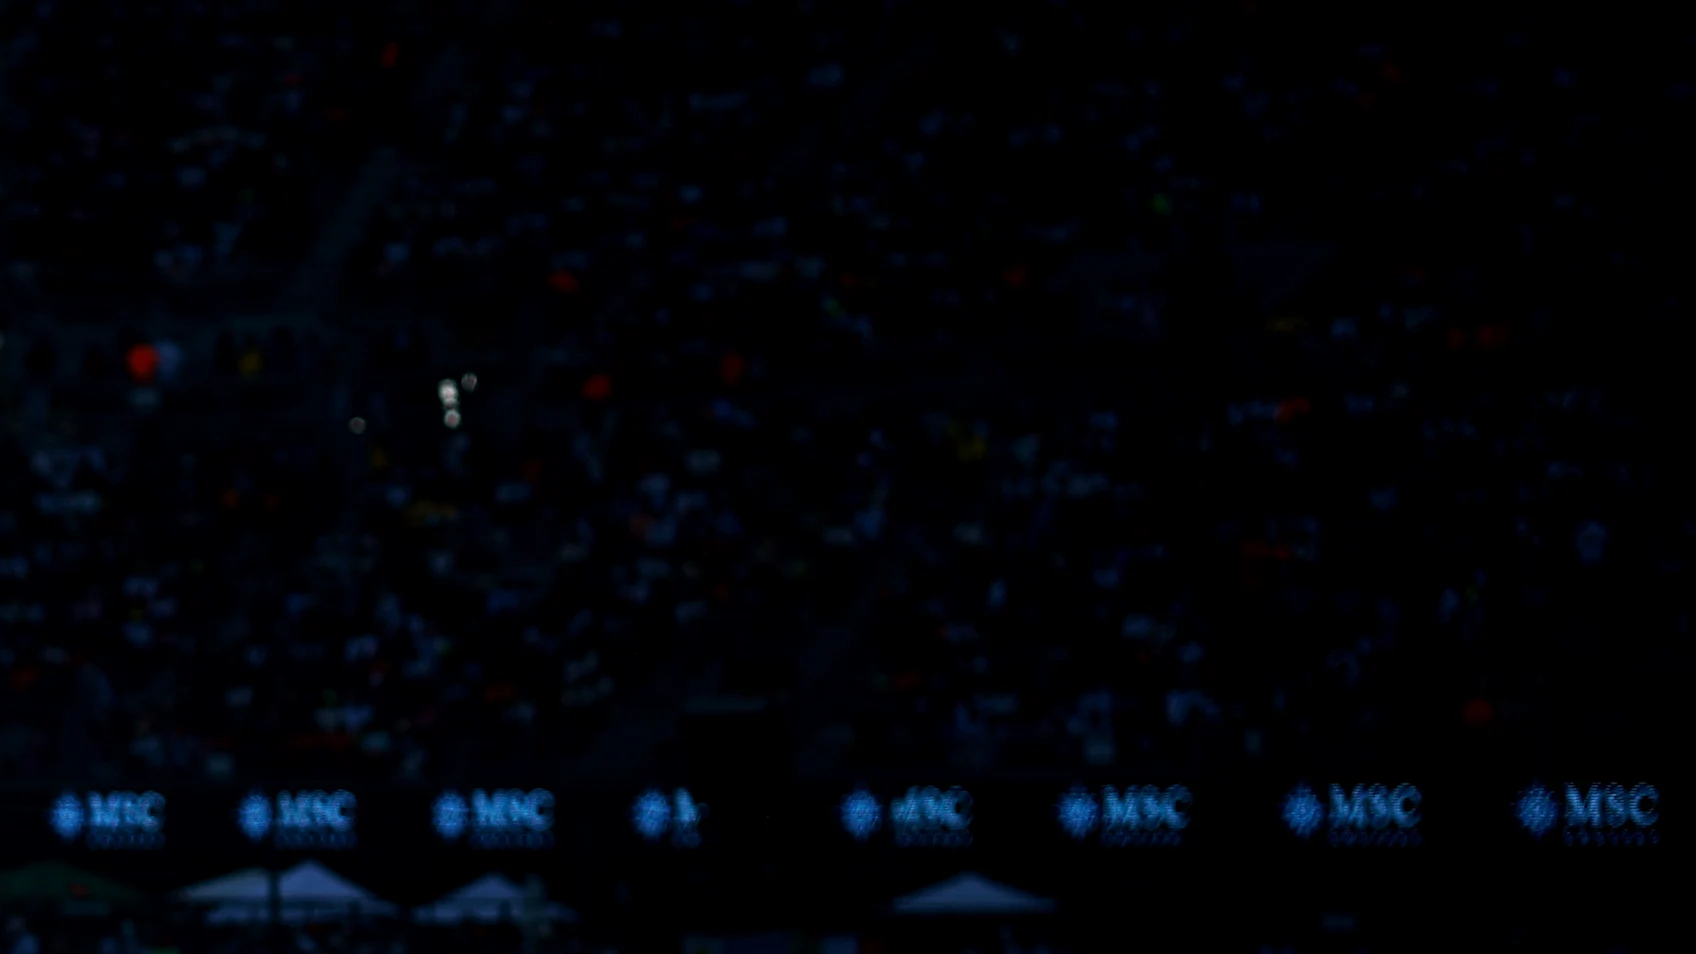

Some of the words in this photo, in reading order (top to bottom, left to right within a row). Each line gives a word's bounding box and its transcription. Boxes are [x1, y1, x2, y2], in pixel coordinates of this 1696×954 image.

[276, 789, 357, 831] MSC
[472, 788, 556, 831] MSC
[1101, 784, 1193, 829] MSC
[1327, 783, 1422, 829] MSC
[1562, 782, 1660, 829] MSC
